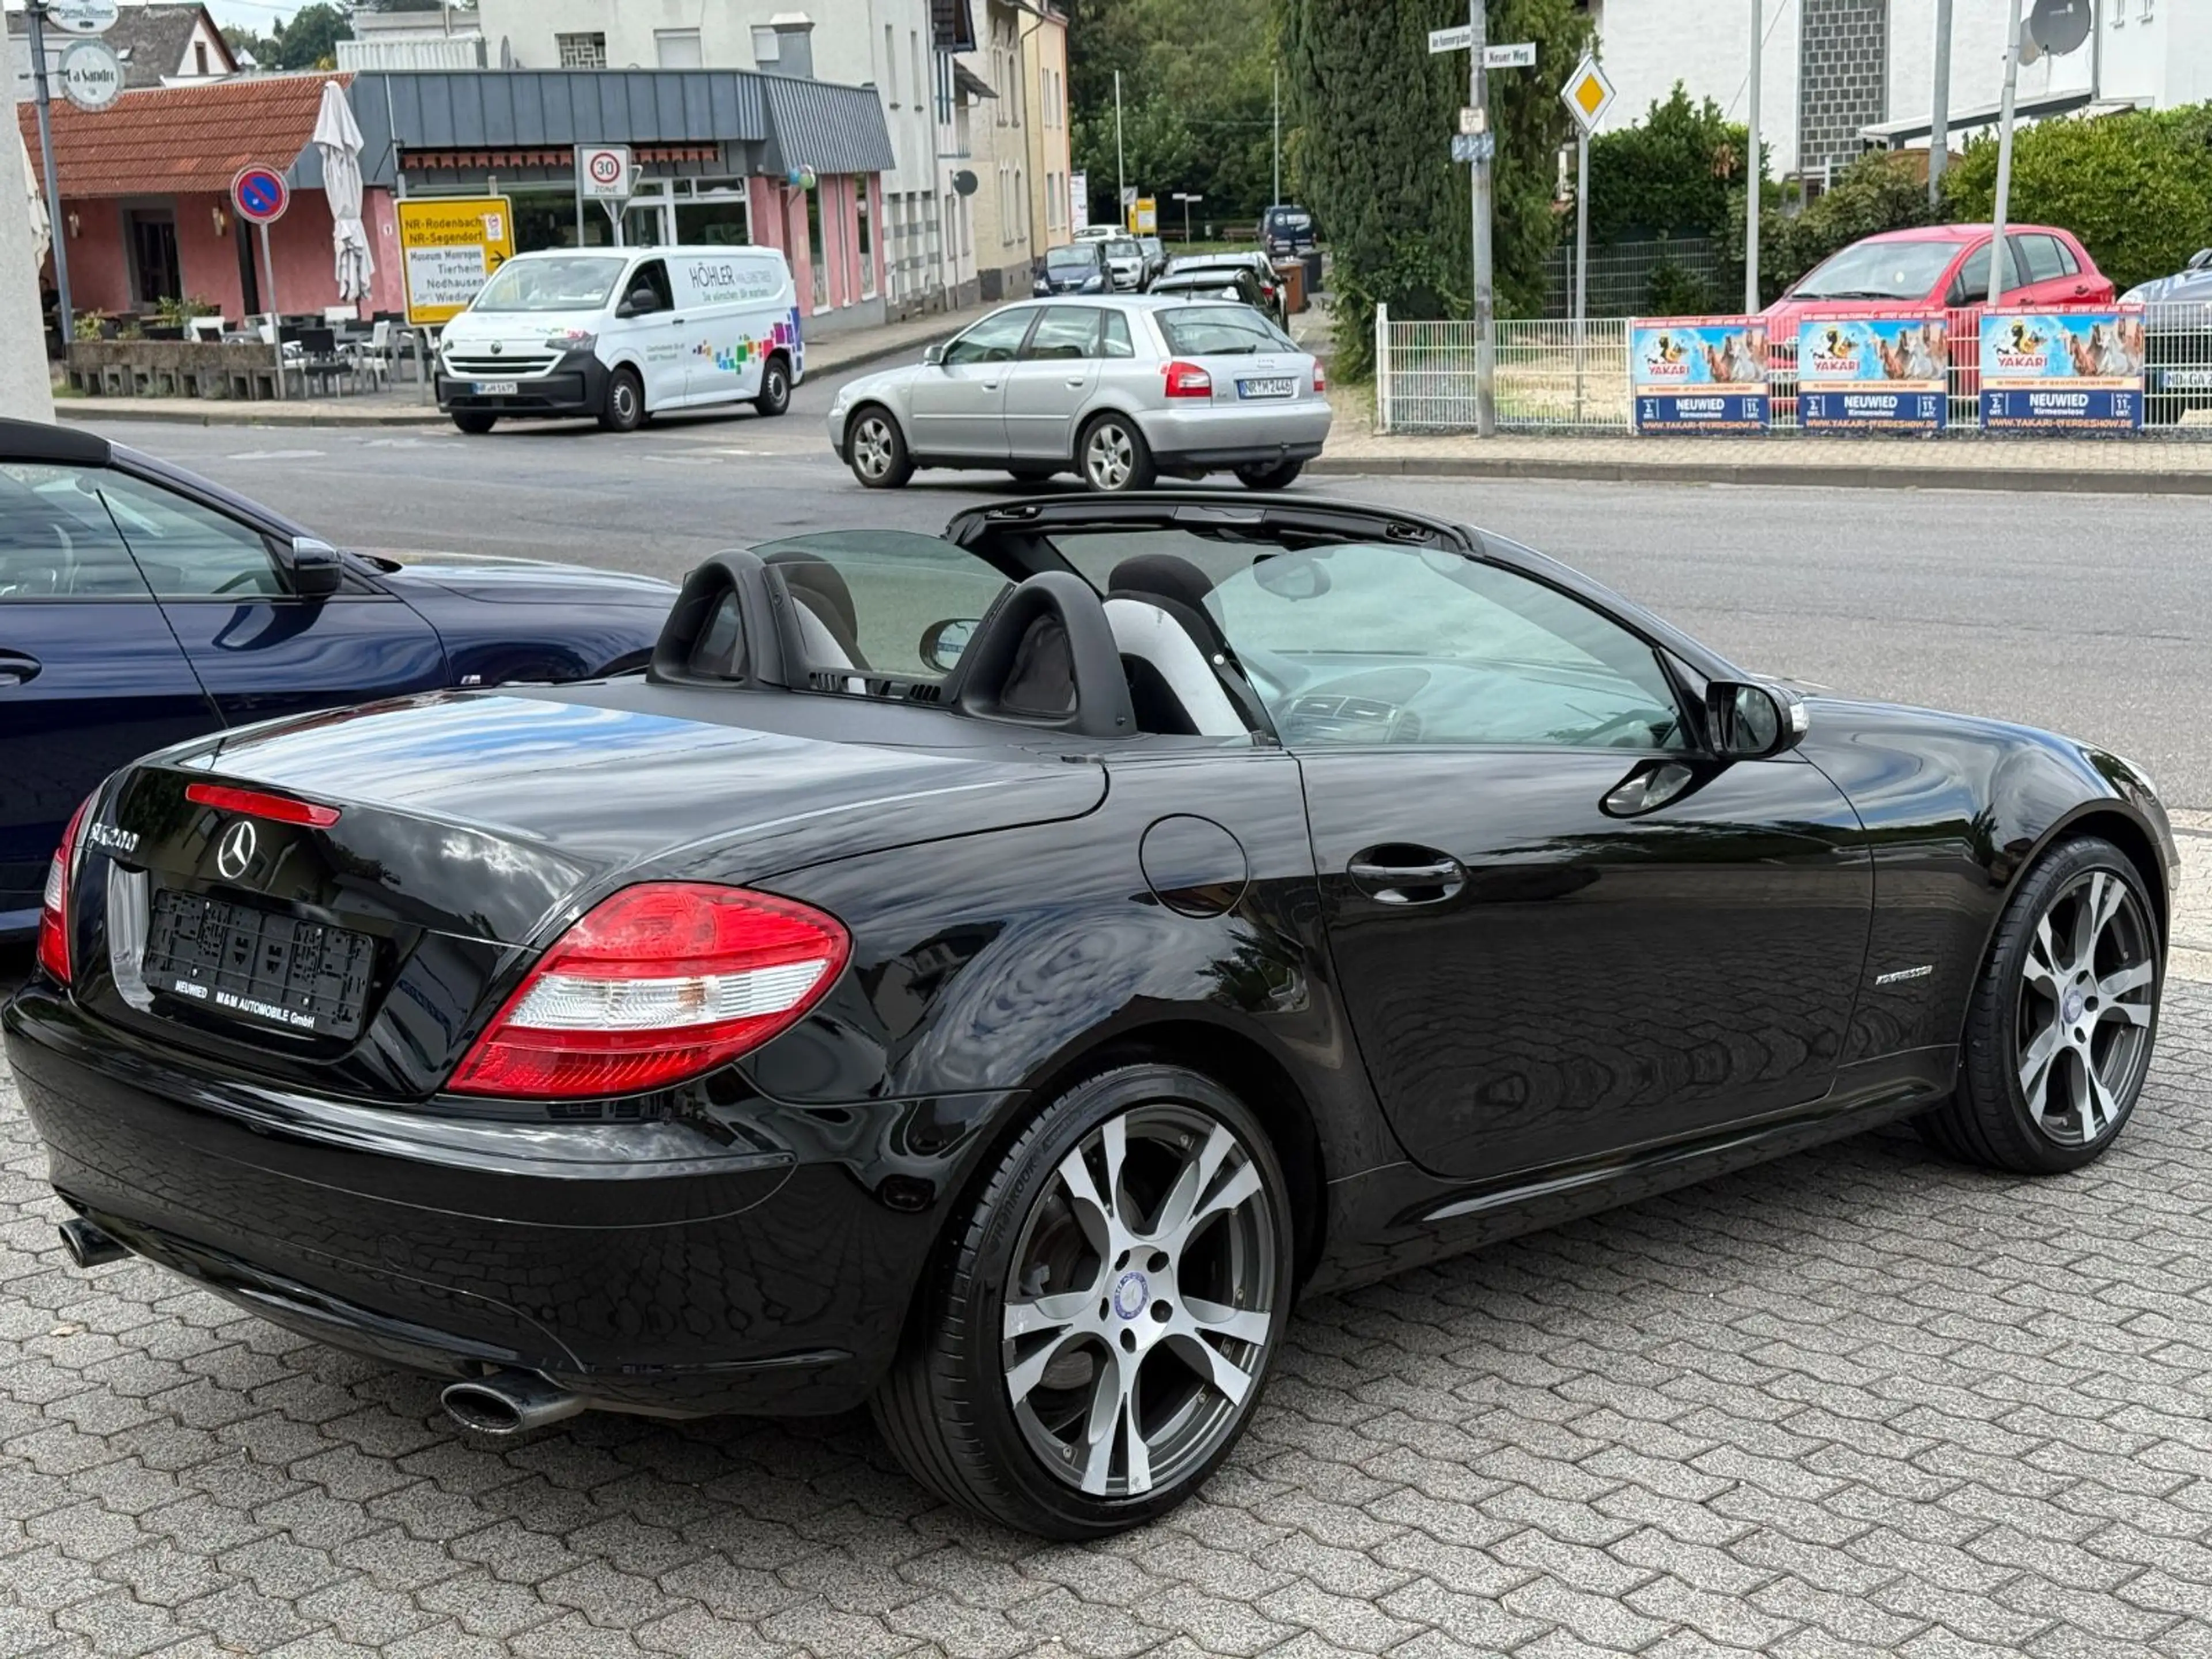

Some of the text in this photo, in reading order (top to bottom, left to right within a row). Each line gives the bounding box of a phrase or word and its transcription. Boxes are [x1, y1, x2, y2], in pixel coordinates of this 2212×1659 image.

[1488, 50, 1529, 63] Neuer Weg
[596, 161, 614, 175] 30
[594, 185, 618, 193] ZONE
[405, 218, 482, 229] NR-Rodenbach
[409, 232, 482, 244] NR-Segendorf
[437, 264, 482, 274] Tierheim
[689, 262, 735, 288] HÖHLER
[1815, 361, 1861, 372] YAKARI
[1998, 357, 2048, 367] YAKARI
[1649, 365, 1690, 376] YAKARI
[1676, 398, 1725, 411] NEUWIED
[1844, 395, 1898, 408] NEUWIED
[2029, 393, 2089, 407] NEUWIED
[175, 979, 316, 1029] NEUWIED M&M AUTOMOBILE GmbH
